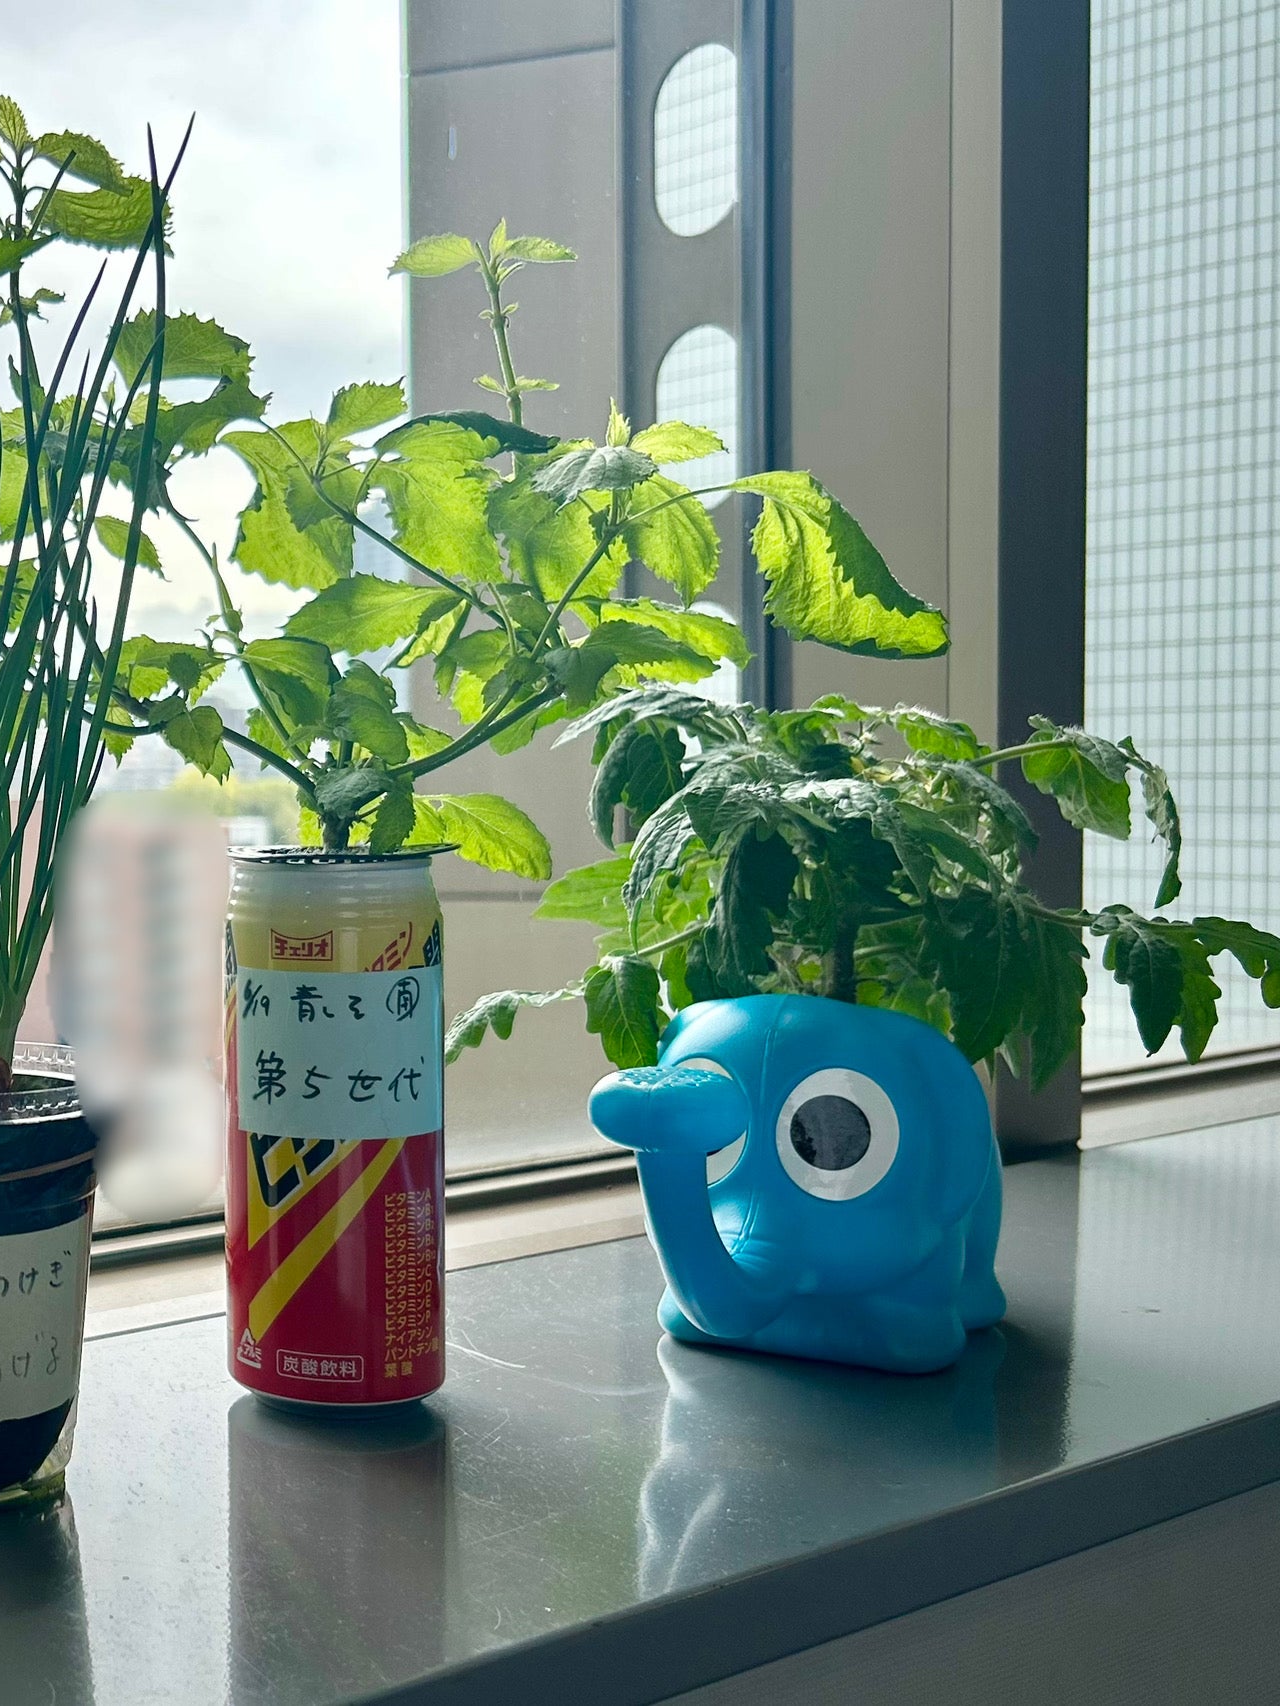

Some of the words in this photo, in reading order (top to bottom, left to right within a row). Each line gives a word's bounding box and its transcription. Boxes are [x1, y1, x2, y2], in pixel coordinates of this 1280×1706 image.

[274, 935, 329, 958] チェリオ
[242, 978, 271, 1019] 6/19
[385, 1187, 432, 1207] ビタミンA
[385, 1264, 432, 1285] ビタミンC
[385, 1280, 432, 1300] ビタミンD
[385, 1295, 431, 1315] ビタミンE
[385, 1310, 431, 1331] ビタミンP
[385, 1326, 433, 1347] ナイアシン
[283, 1355, 357, 1378] 炭酸飲料
